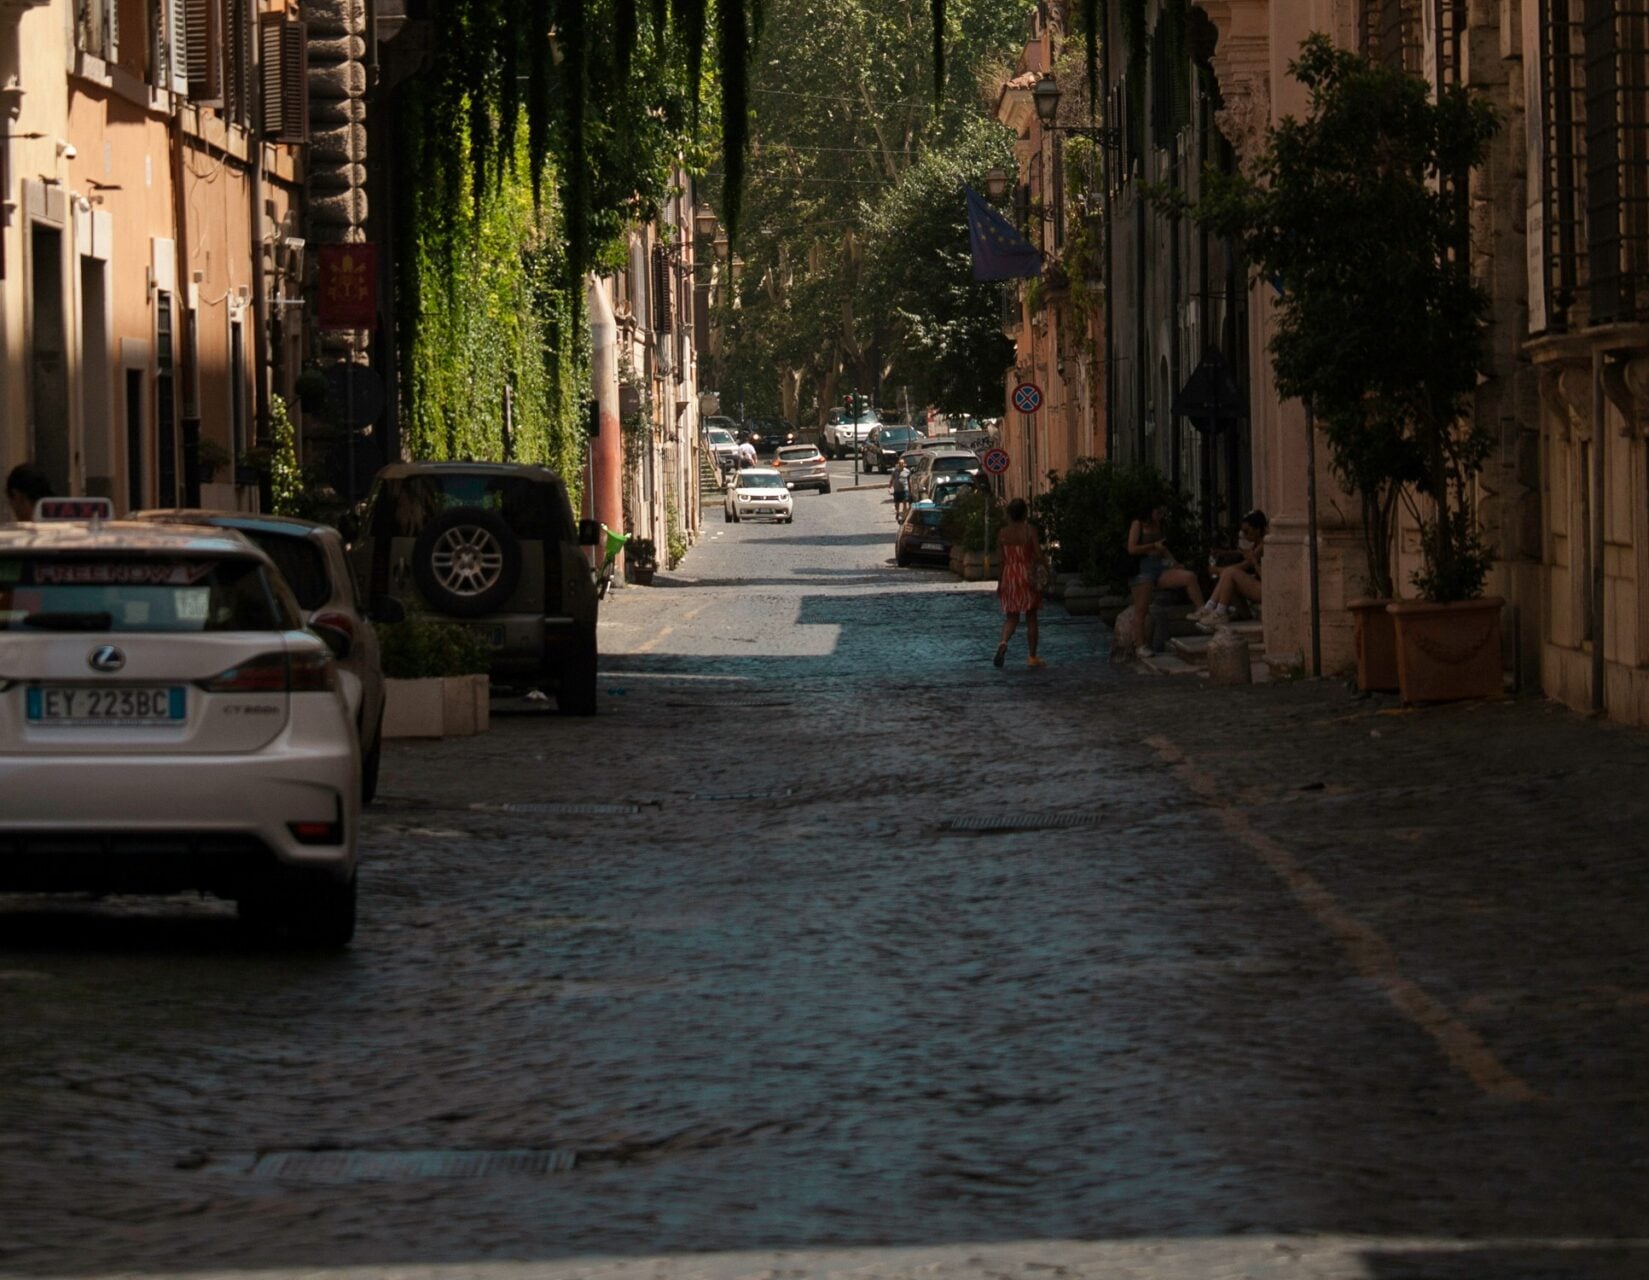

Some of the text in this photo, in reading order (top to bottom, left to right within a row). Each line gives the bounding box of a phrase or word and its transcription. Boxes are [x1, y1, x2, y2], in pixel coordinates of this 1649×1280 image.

[43, 501, 107, 518] TAXI
[45, 690, 168, 717] EY 223BC
